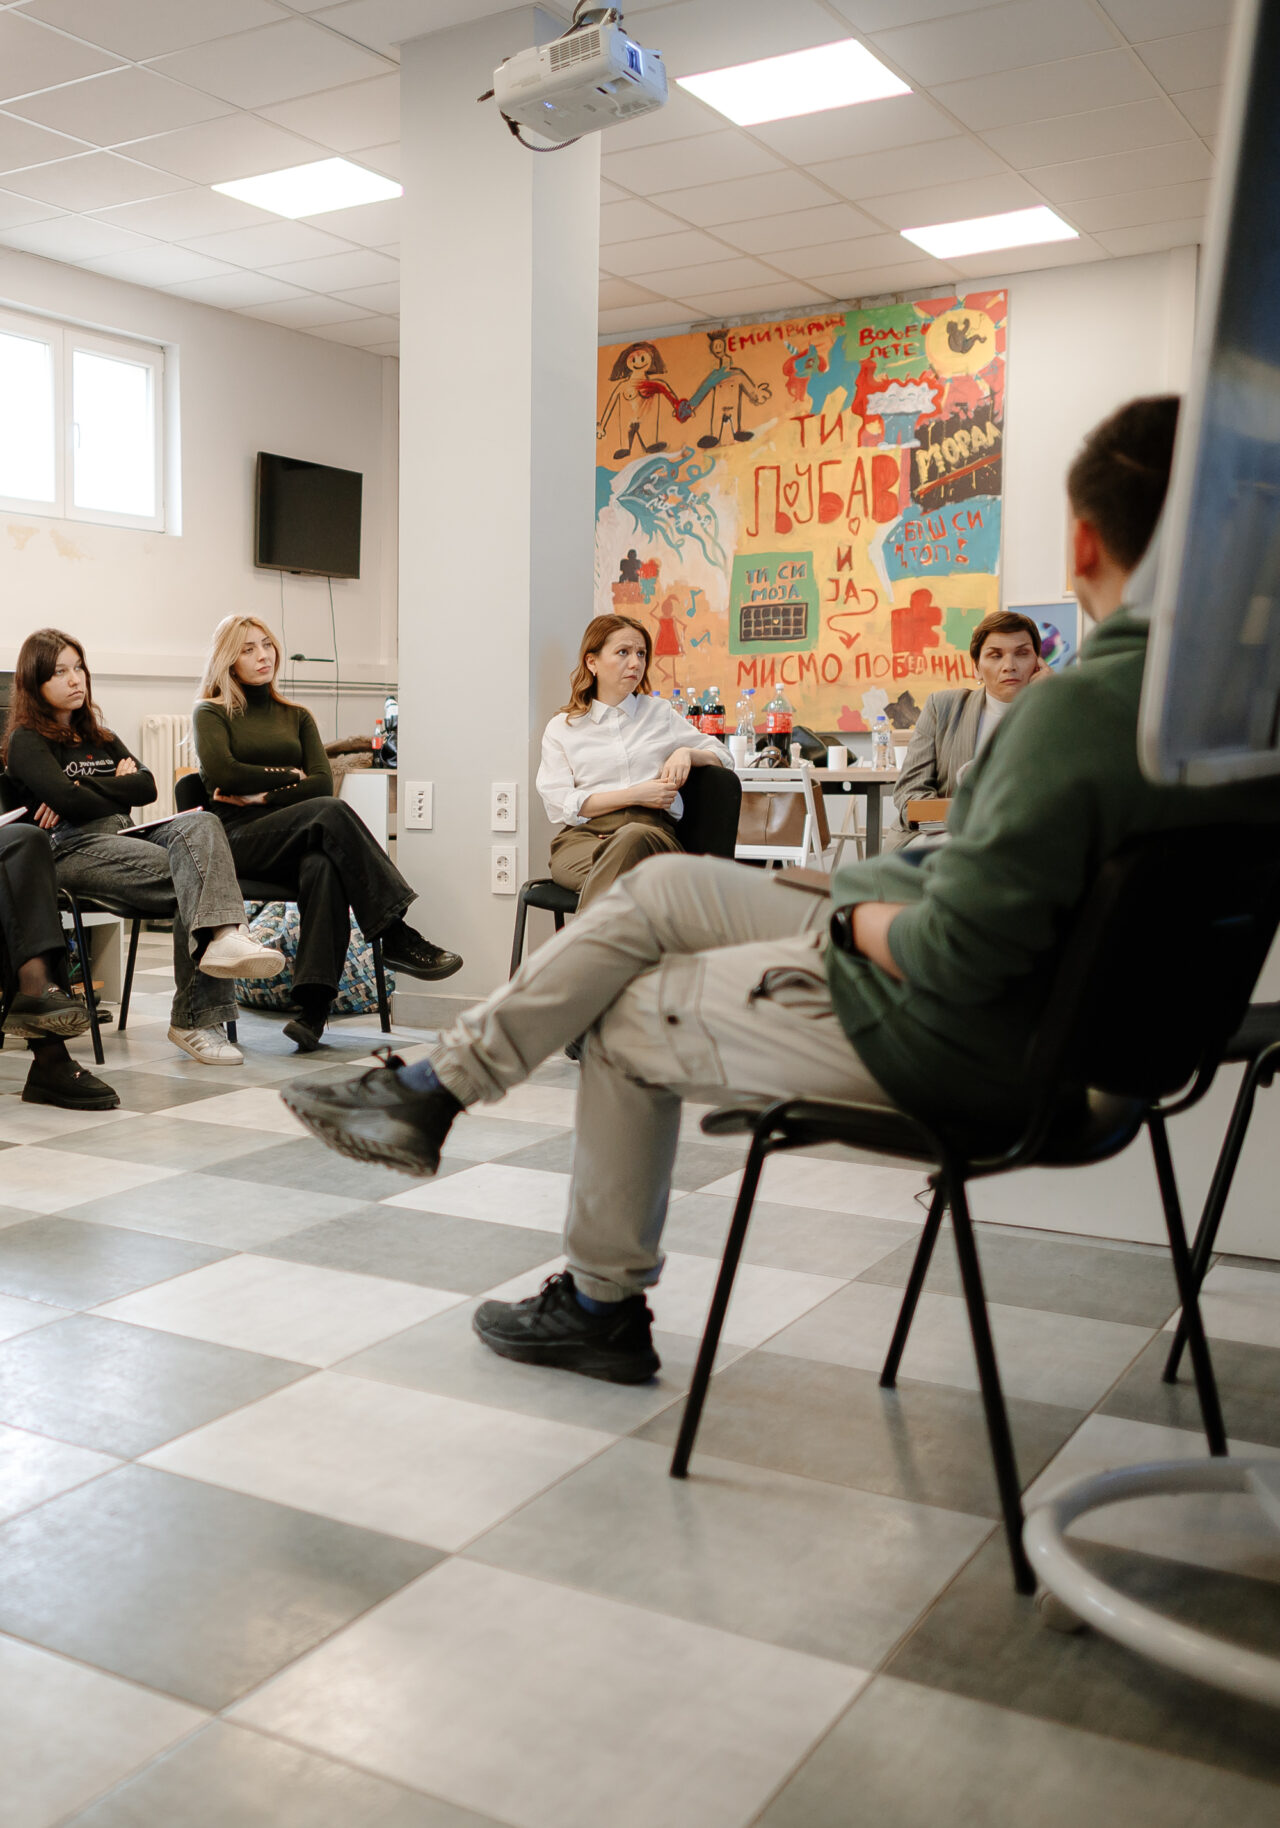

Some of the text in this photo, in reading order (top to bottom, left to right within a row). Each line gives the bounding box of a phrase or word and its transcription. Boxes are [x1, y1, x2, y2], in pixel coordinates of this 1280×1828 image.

[790, 413, 843, 447] ТИ
[916, 421, 1001, 485] МОРАЛ
[952, 509, 984, 531] СИ
[837, 545, 853, 572] И
[746, 564, 805, 584] ТИ СИ
[751, 584, 800, 602] МОЈА
[826, 578, 861, 605] ЈА
[855, 652, 976, 683] ПОБЕДНИЦ
